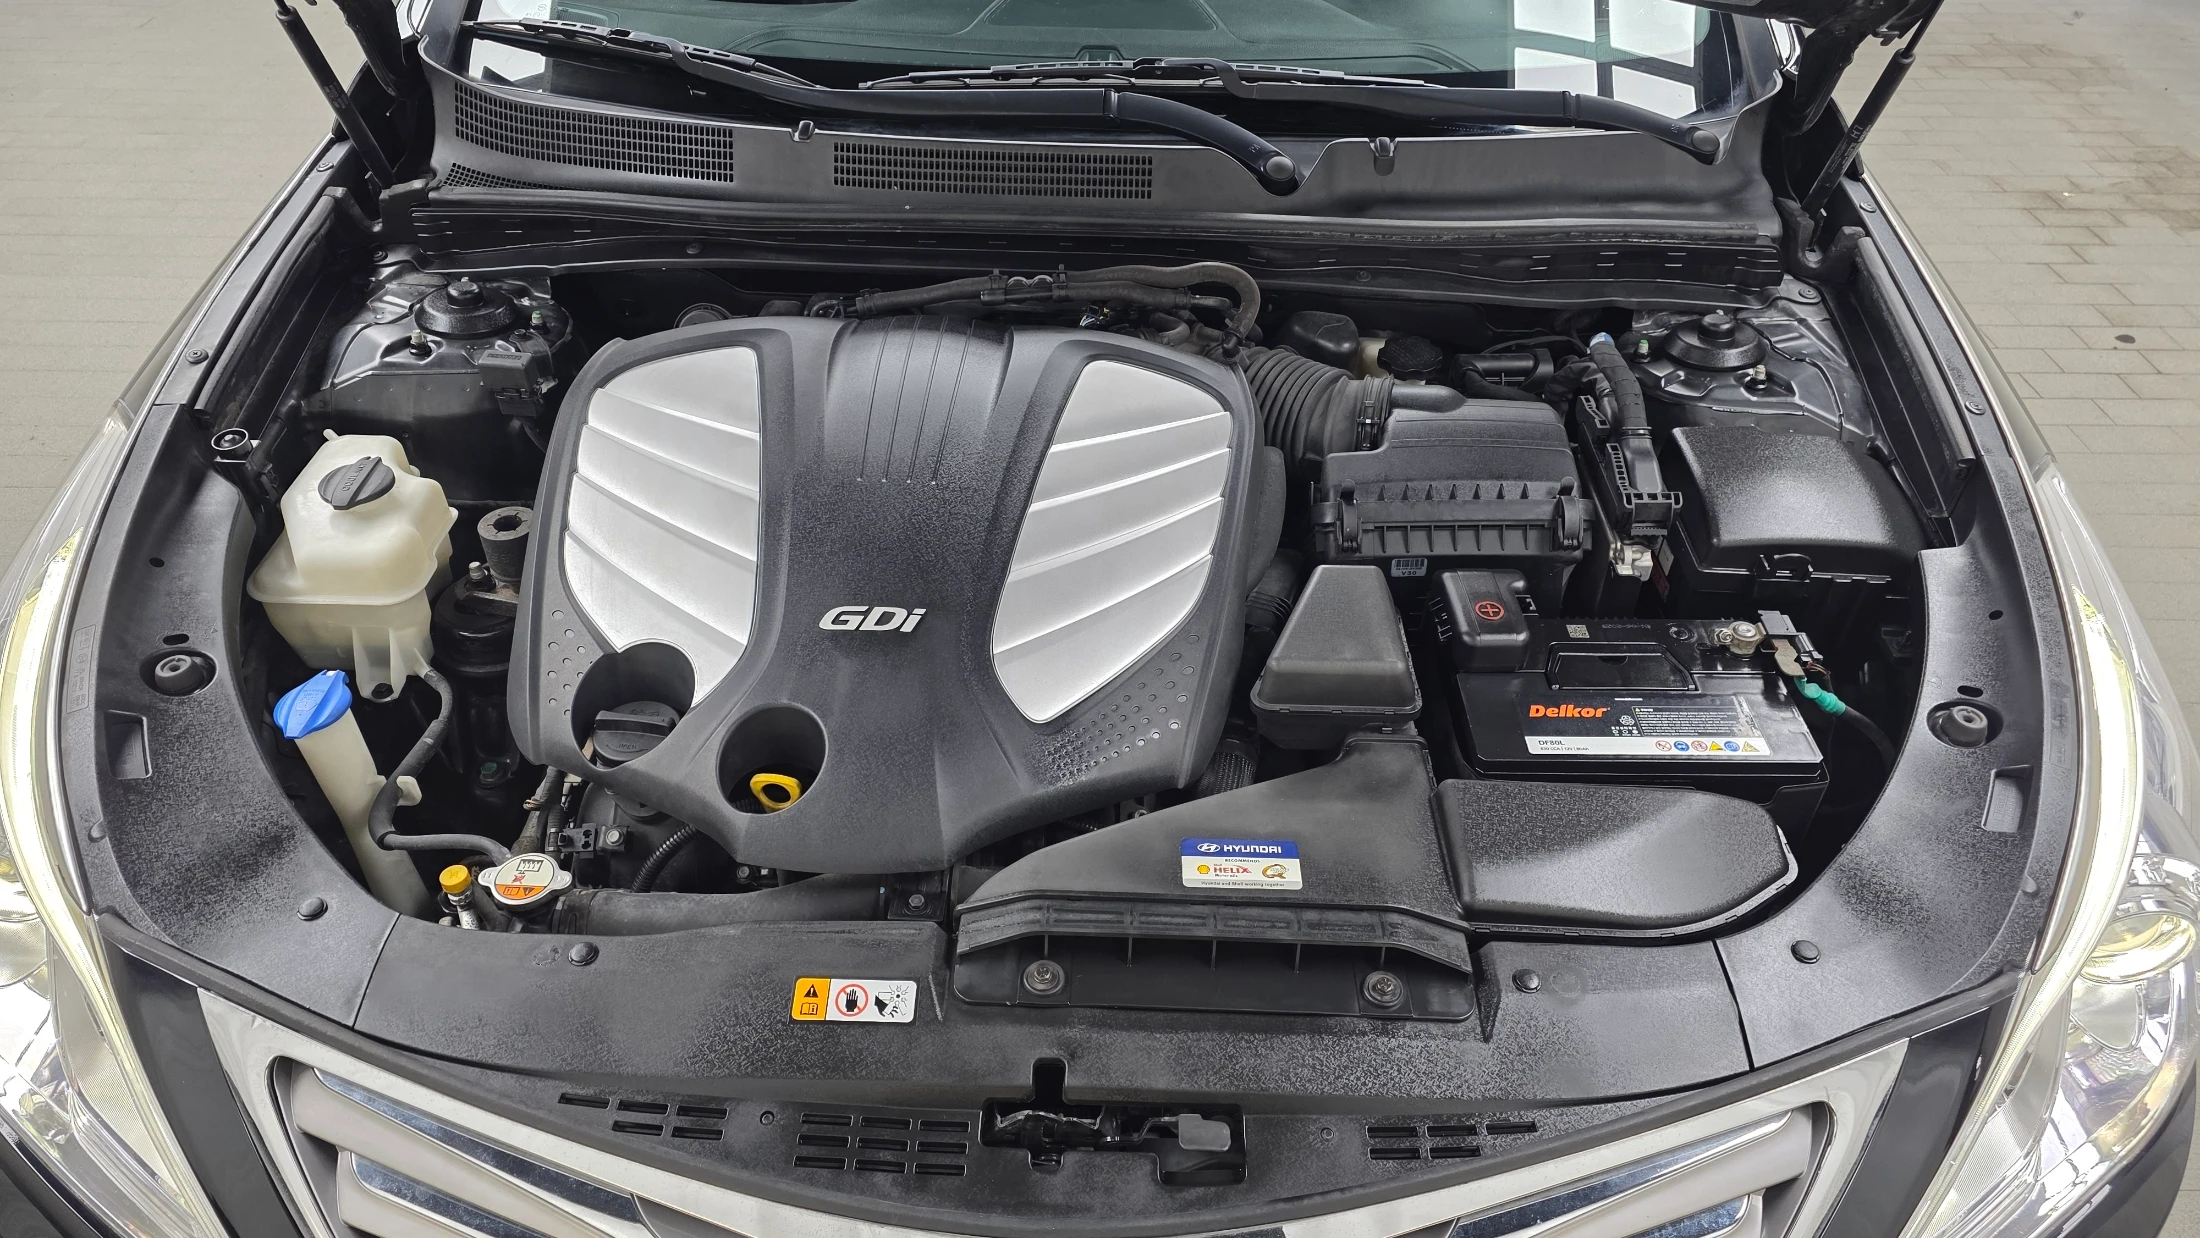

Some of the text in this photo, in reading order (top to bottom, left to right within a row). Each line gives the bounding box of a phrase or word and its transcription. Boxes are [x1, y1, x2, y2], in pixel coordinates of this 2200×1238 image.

[818, 605, 927, 633] GDi
[1529, 704, 1607, 718] Delkor
[1223, 844, 1282, 854] HYUNDAI
[1213, 866, 1251, 874] HELIX
